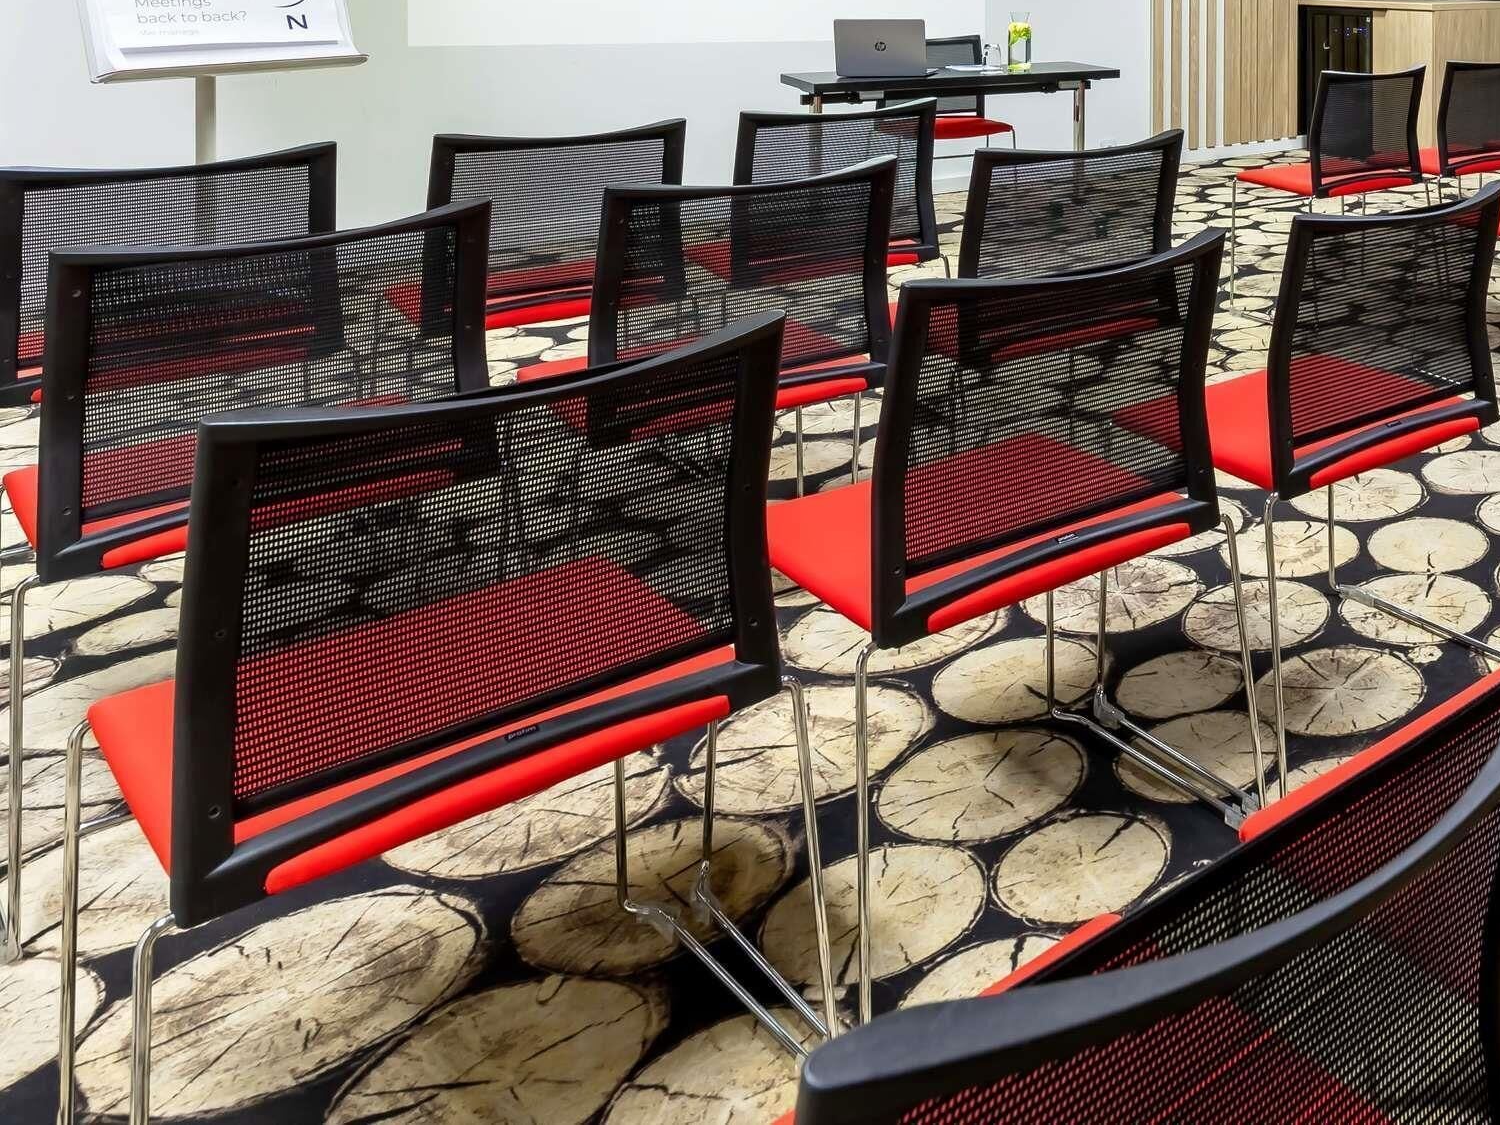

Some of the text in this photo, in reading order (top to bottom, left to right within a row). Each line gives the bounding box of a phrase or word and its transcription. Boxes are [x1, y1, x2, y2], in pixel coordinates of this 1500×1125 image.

[136, 10, 247, 24] back to back?
